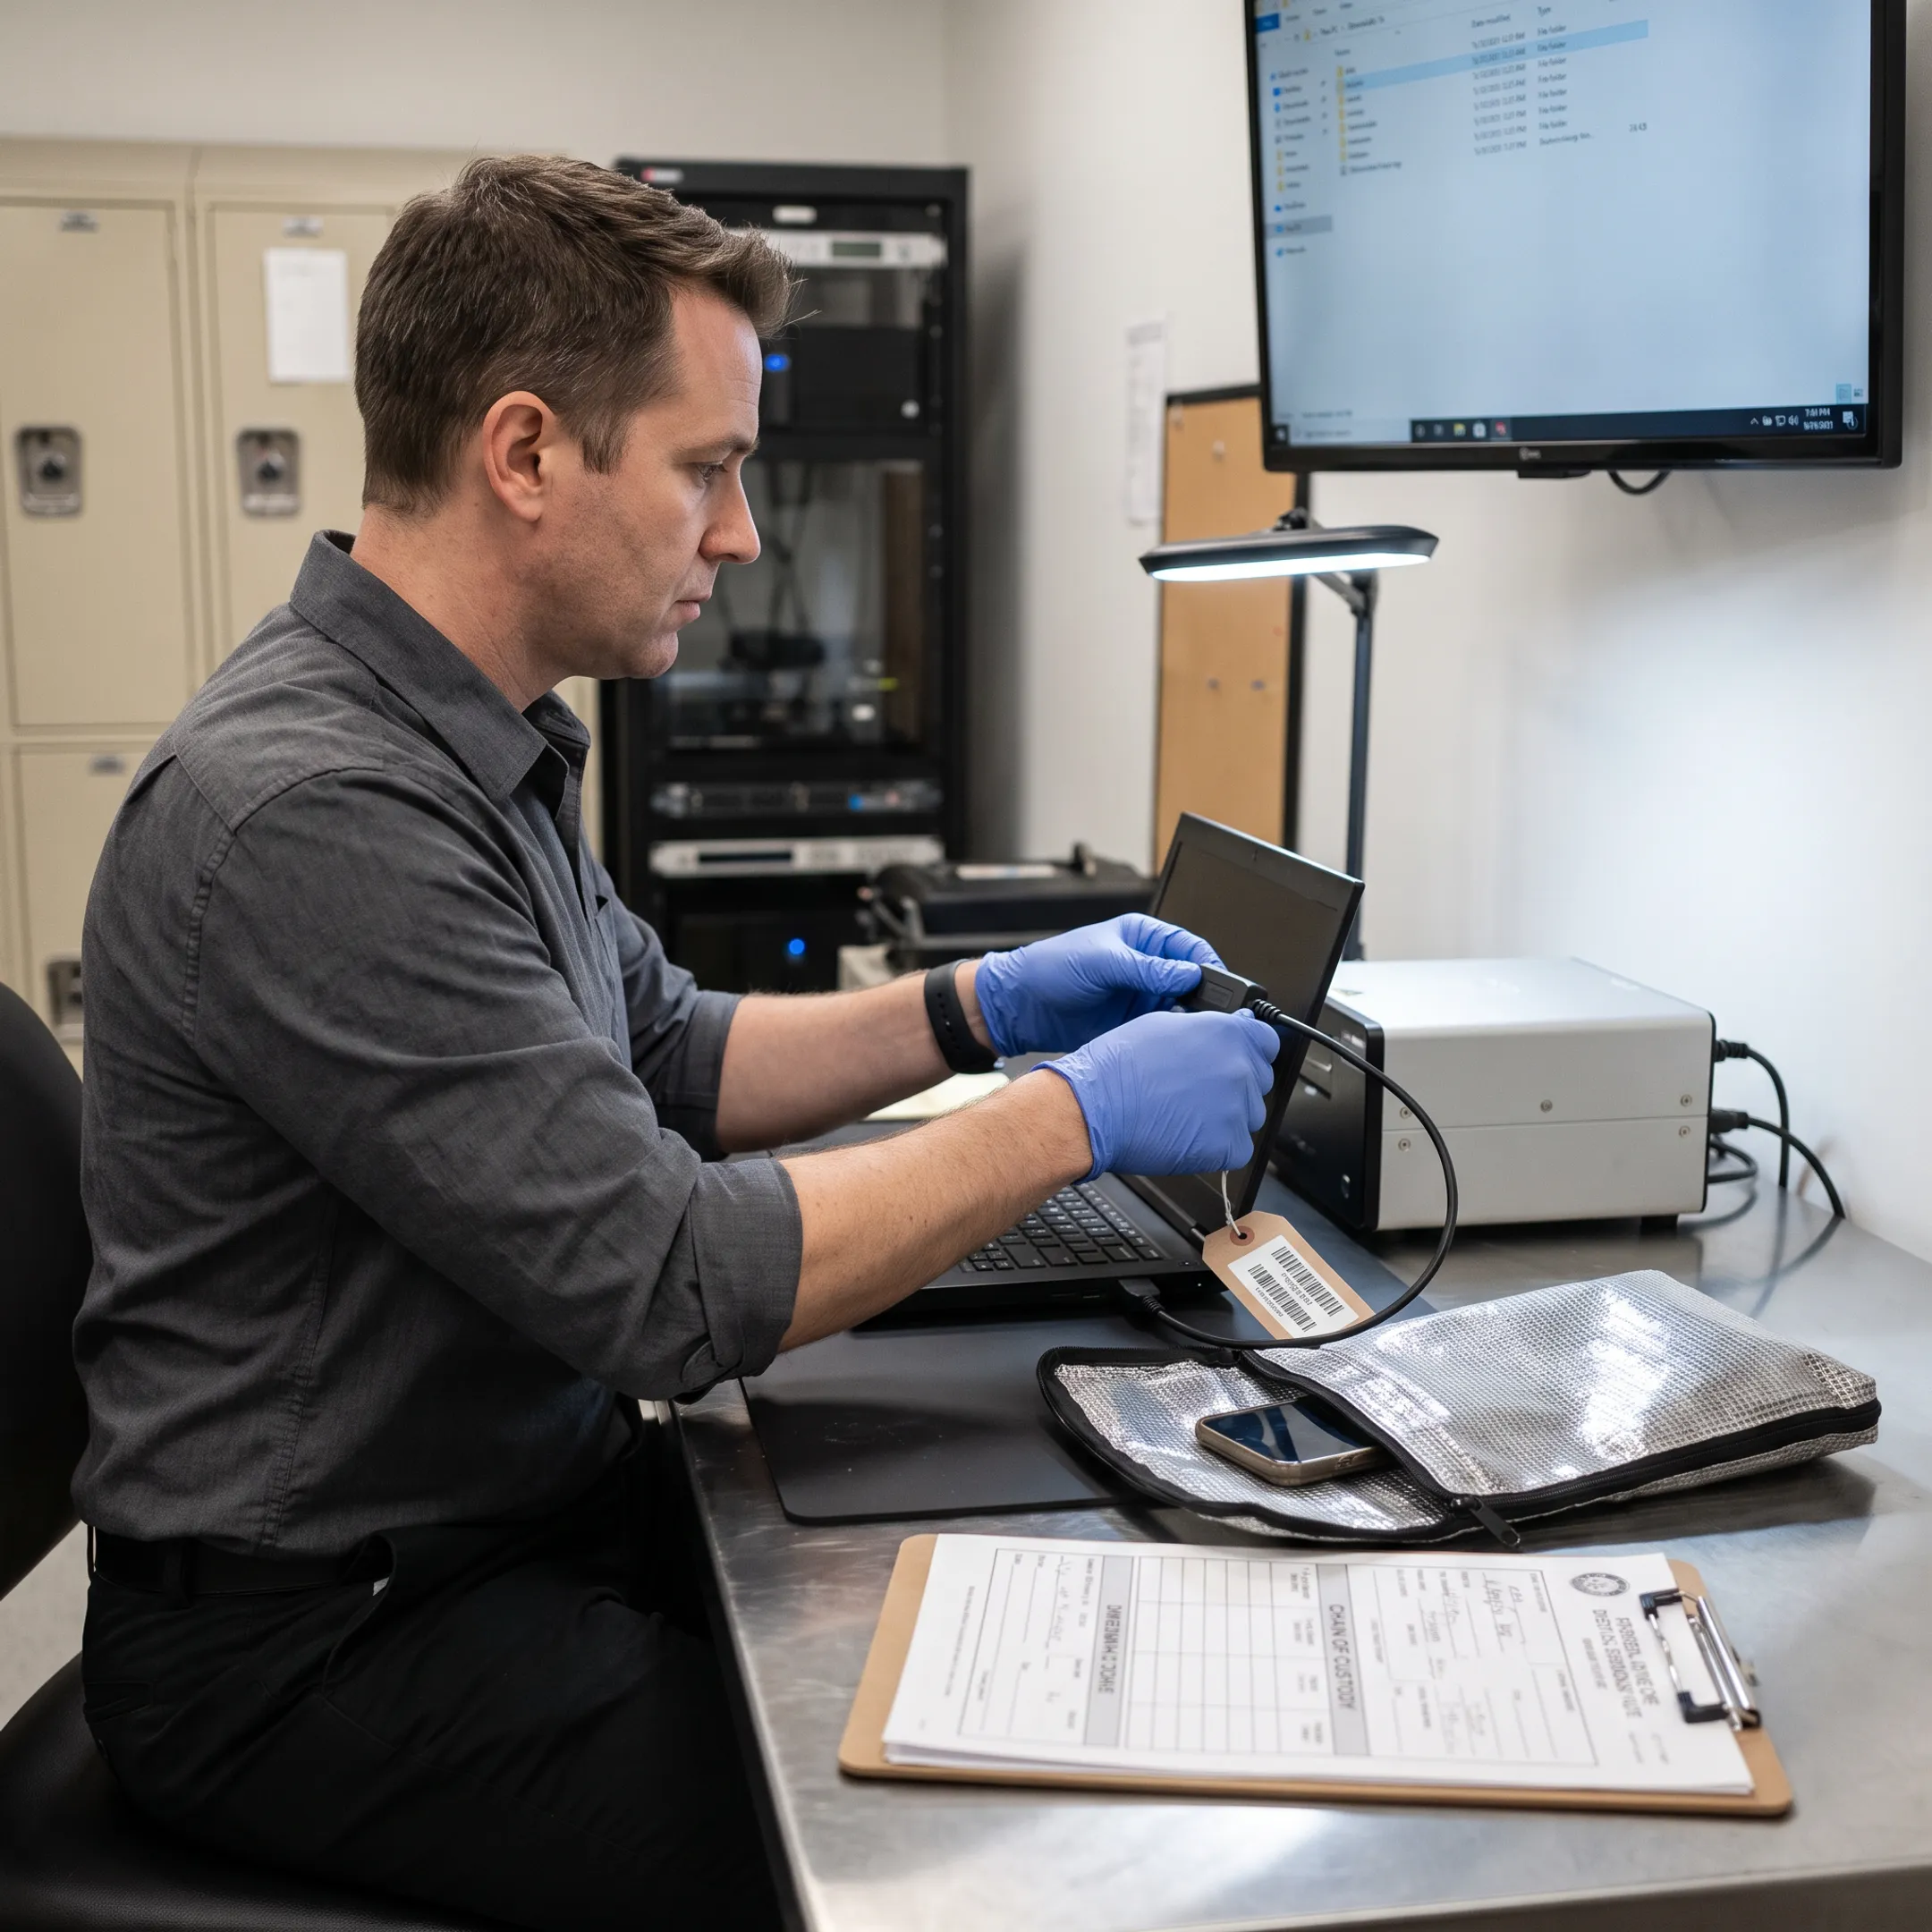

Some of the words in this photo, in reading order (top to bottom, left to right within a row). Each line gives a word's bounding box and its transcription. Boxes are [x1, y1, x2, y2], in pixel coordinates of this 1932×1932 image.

[1328, 1604, 1347, 1637] CHAIN
[1331, 1639, 1351, 1654] OF
[1334, 1656, 1357, 1709] CUSTODY
